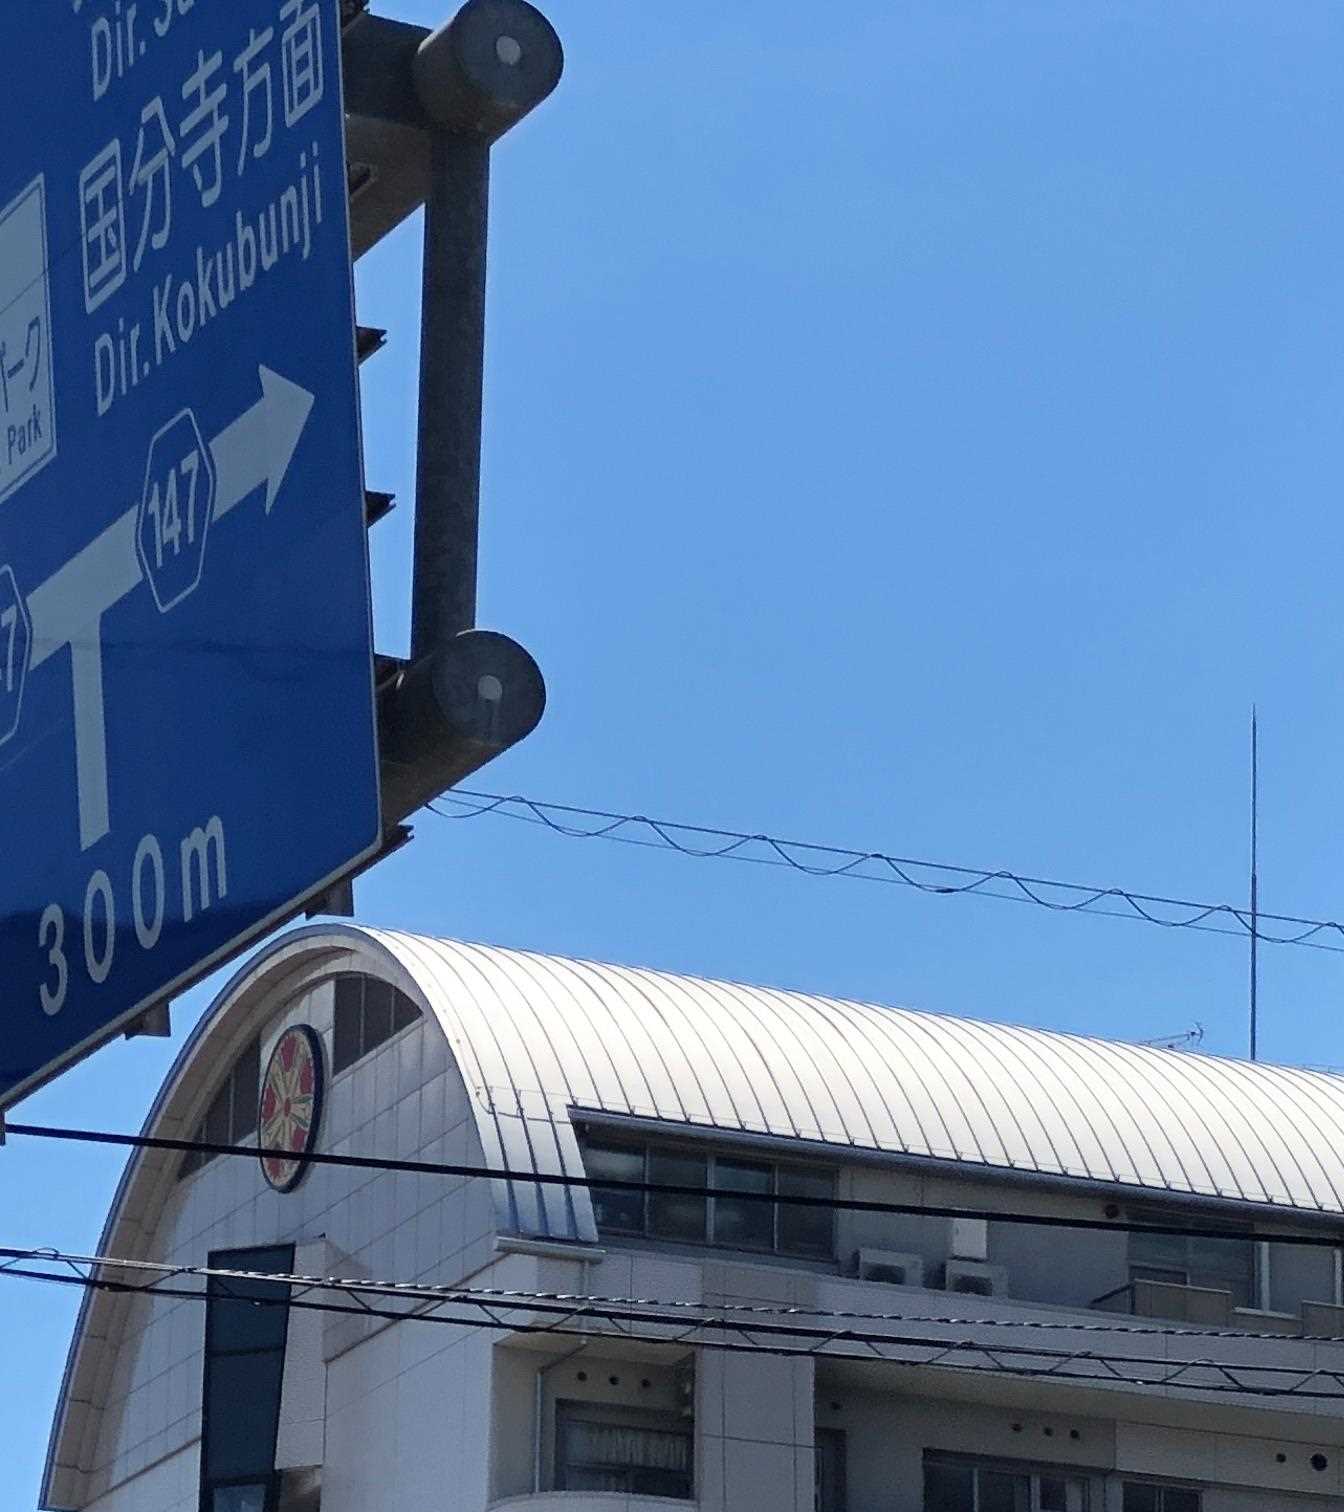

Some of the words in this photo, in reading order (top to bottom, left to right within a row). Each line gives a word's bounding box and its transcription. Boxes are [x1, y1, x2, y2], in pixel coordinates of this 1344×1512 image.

[91, 0, 146, 101] Dir.
[79, 0, 324, 314] 国分寺方面
[94, 318, 150, 417] Dir.
[152, 140, 323, 366] Kokubunji
[7, 403, 43, 465] Park
[148, 449, 200, 570] 147
[38, 814, 229, 1016] 300m
